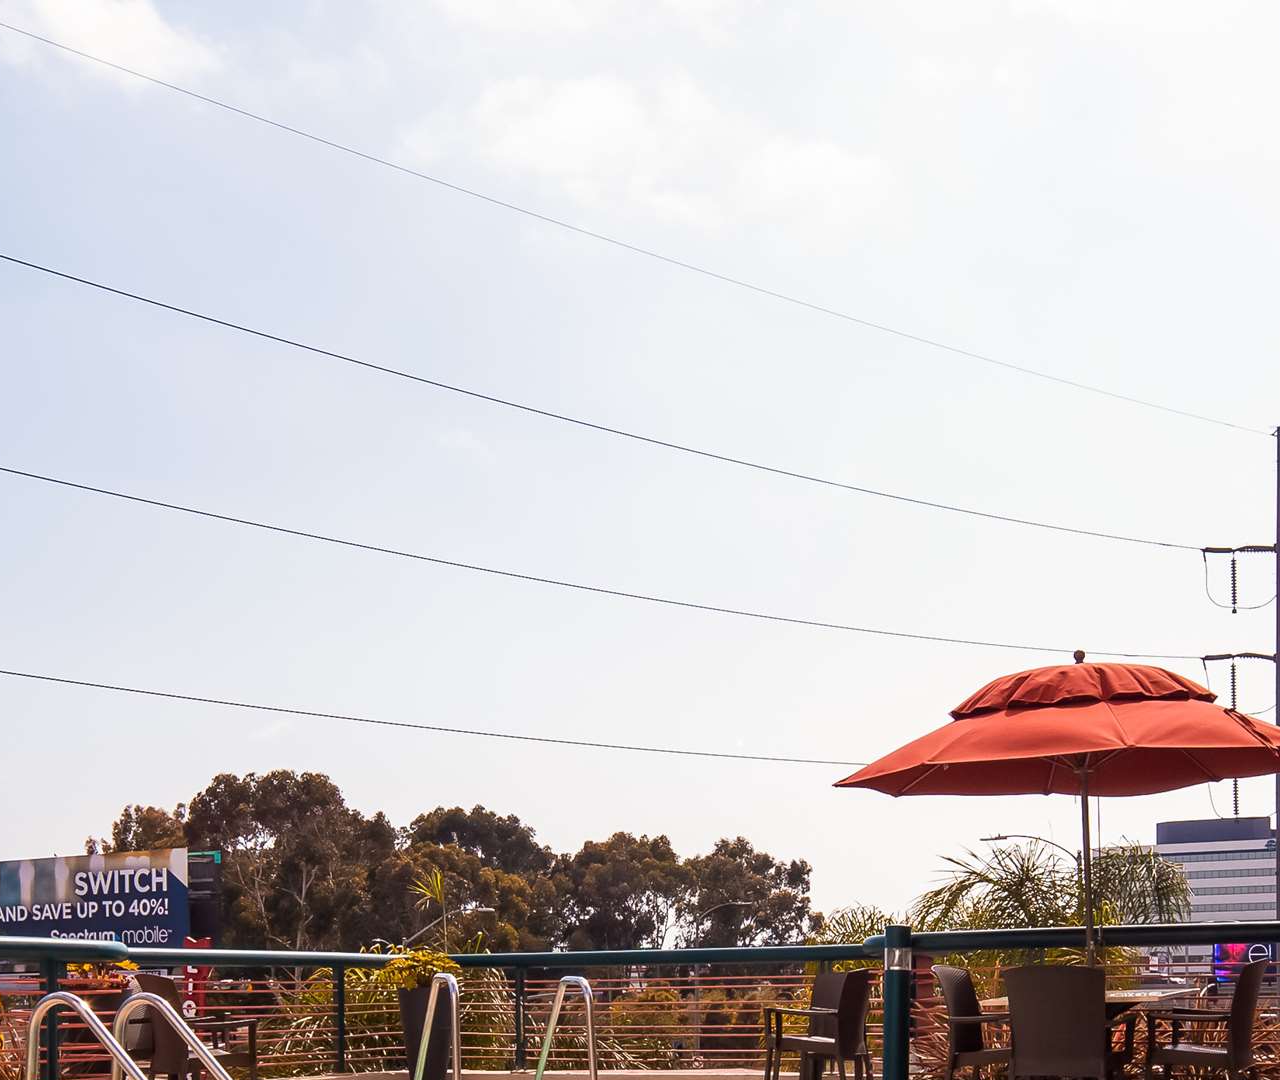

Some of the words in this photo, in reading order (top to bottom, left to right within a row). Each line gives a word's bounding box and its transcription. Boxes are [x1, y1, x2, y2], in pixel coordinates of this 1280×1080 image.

[74, 867, 168, 896] SWITCH
[31, 902, 72, 920] SAVE
[76, 901, 98, 918] UP
[101, 900, 124, 917] TO
[128, 898, 169, 916] 40%!
